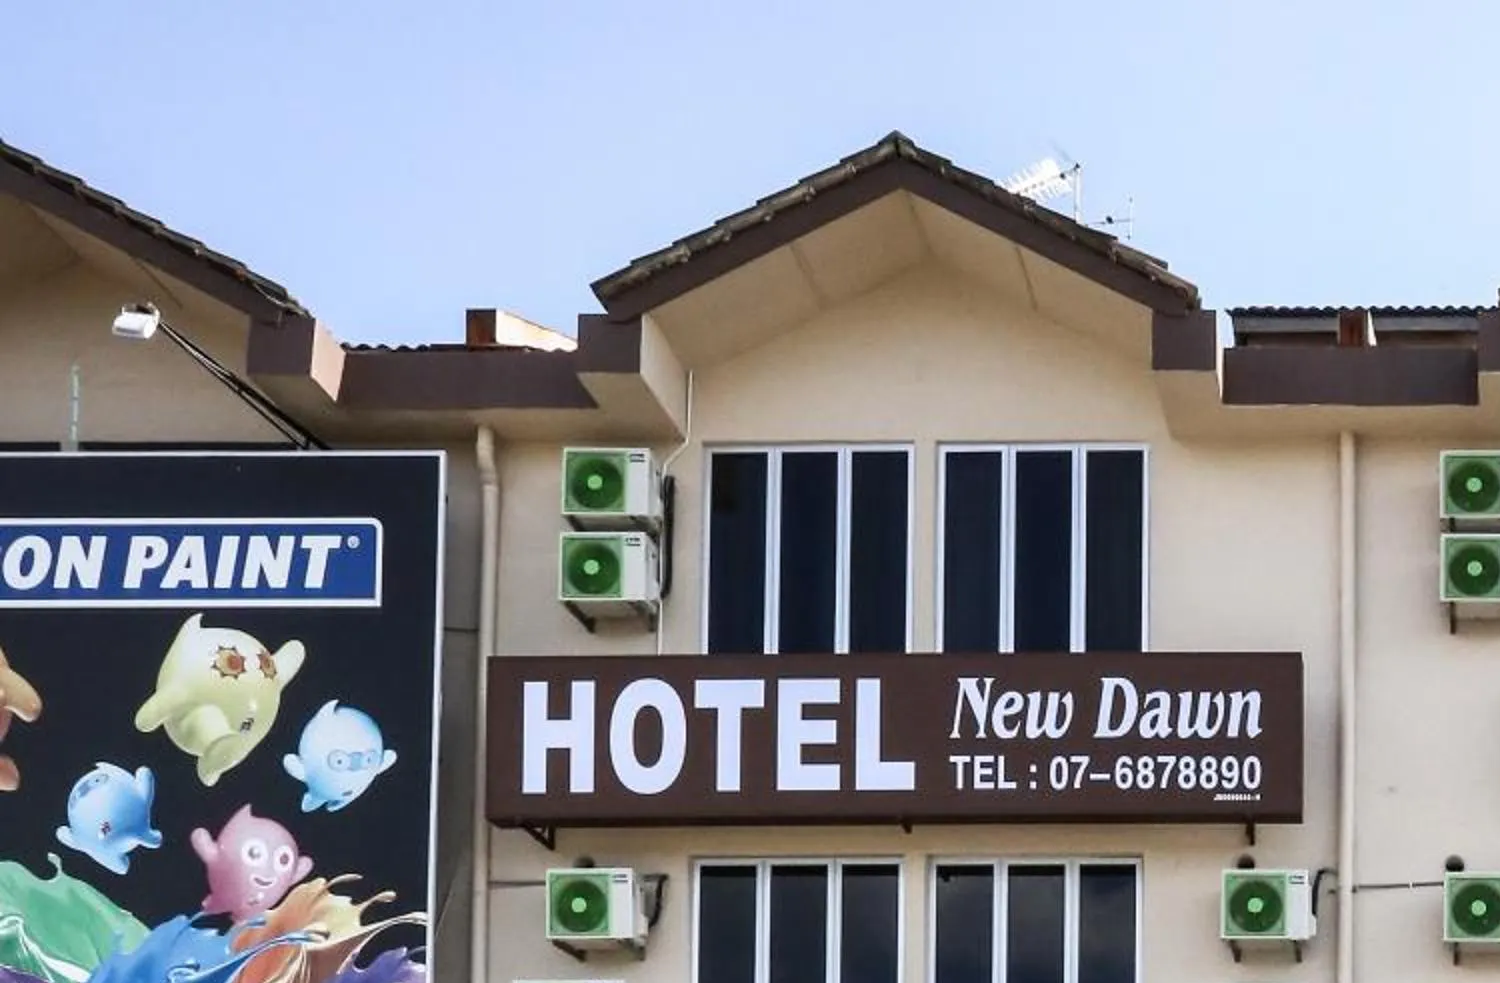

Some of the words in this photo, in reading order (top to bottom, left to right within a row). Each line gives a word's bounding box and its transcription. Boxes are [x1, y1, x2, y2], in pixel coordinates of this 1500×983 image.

[0, 535, 107, 590] ON
[522, 677, 915, 795] HOTEL
[950, 676, 1073, 740] New
[1093, 676, 1263, 740] Dawn
[1049, 755, 1262, 790] 07-6878890
